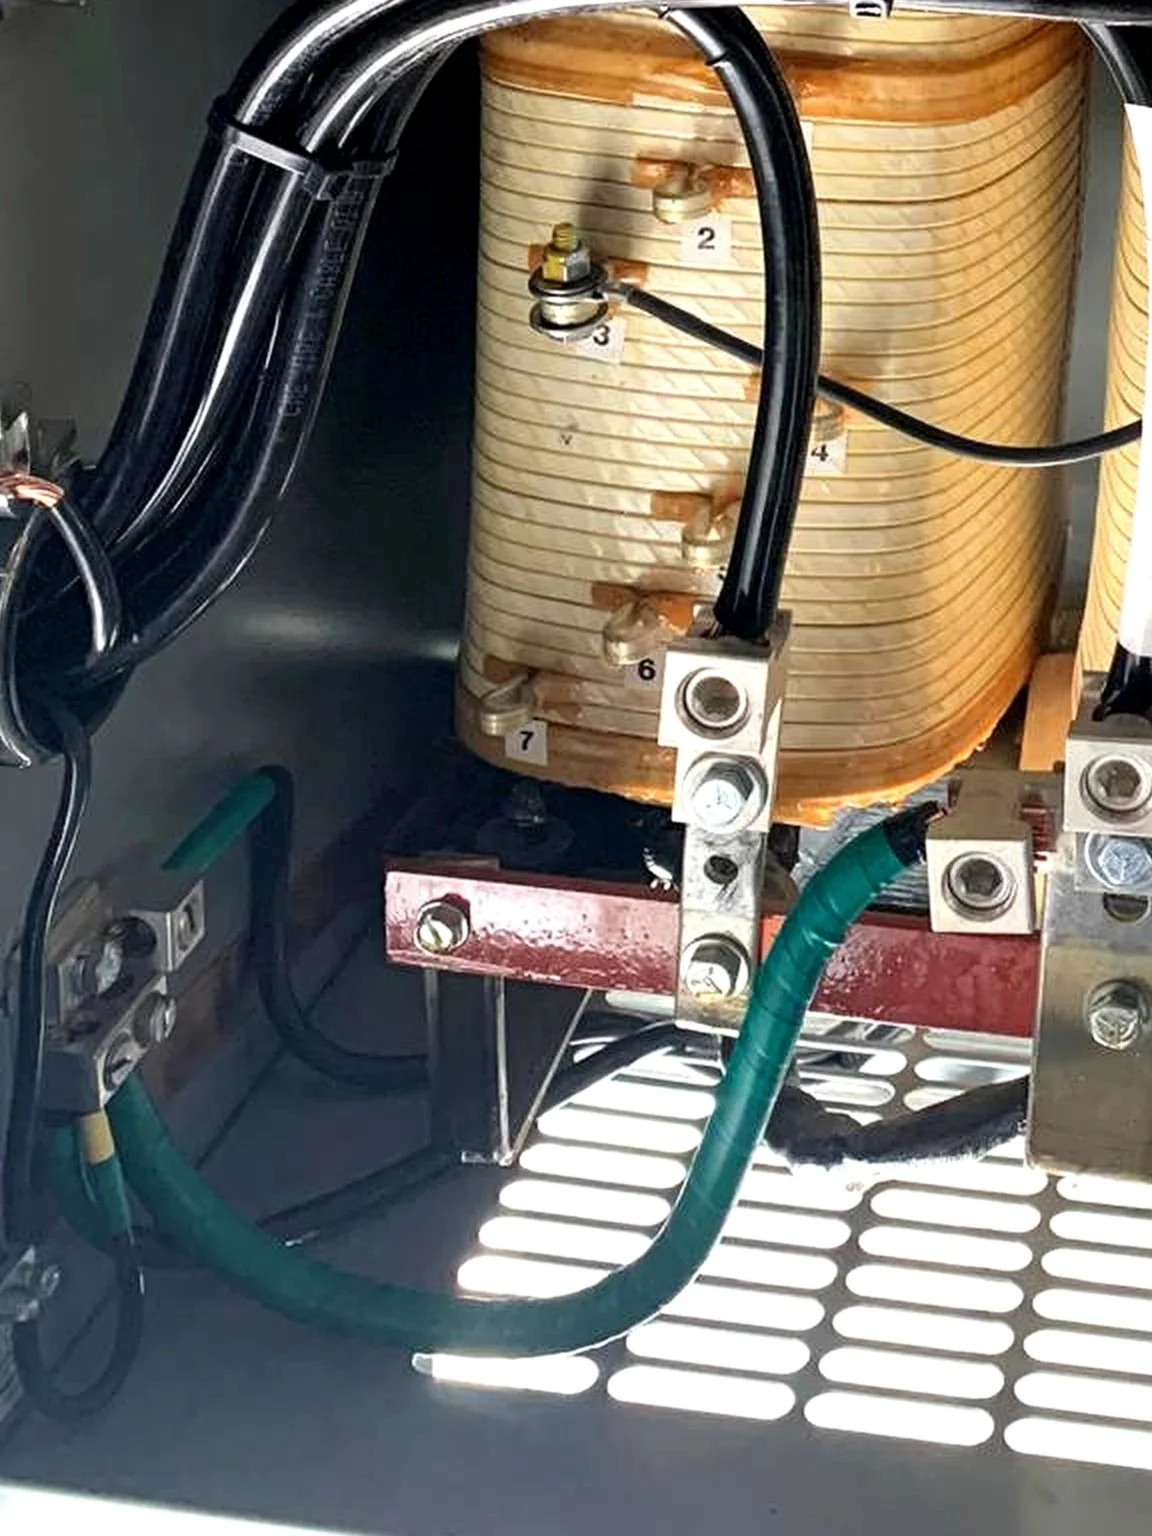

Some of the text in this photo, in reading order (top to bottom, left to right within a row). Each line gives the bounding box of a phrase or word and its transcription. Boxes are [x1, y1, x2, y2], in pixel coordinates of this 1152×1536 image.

[697, 227, 716, 250] 2
[593, 324, 610, 346] 3
[810, 444, 829, 462] 4
[638, 658, 656, 681] 6
[519, 730, 535, 751] 7
